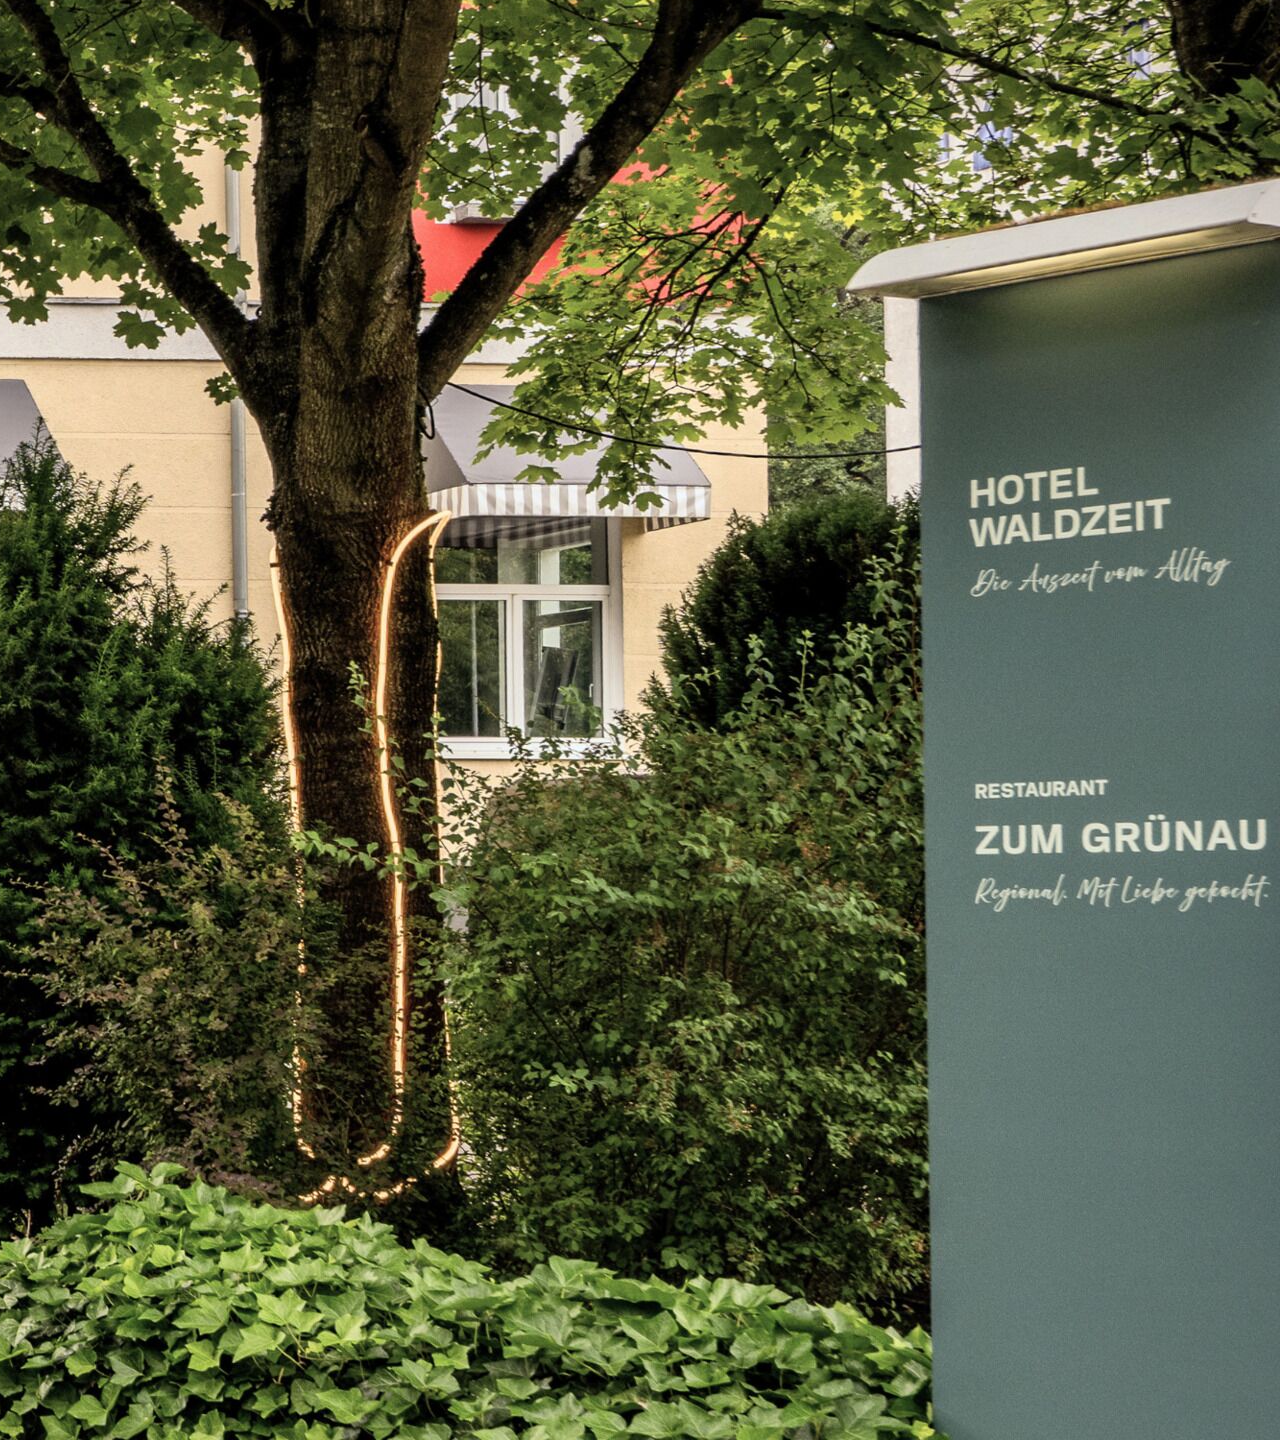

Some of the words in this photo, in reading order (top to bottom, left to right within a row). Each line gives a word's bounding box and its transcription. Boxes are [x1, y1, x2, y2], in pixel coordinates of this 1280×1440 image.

[970, 466, 1100, 509] HOTEL
[968, 497, 1172, 548] WALDZEIT
[970, 568, 1013, 598] Die
[1017, 559, 1104, 594] Auszeit
[1104, 565, 1149, 584] vom
[1154, 546, 1232, 587] Alltag
[974, 778, 1109, 799] RESTAURANT
[974, 823, 1064, 855] ZUM
[1081, 814, 1268, 854] GRÜNAU
[974, 873, 1068, 913] Regional.
[1077, 875, 1119, 908] Mit
[1120, 875, 1179, 905] Liebe
[1178, 874, 1272, 913] gekocht.
